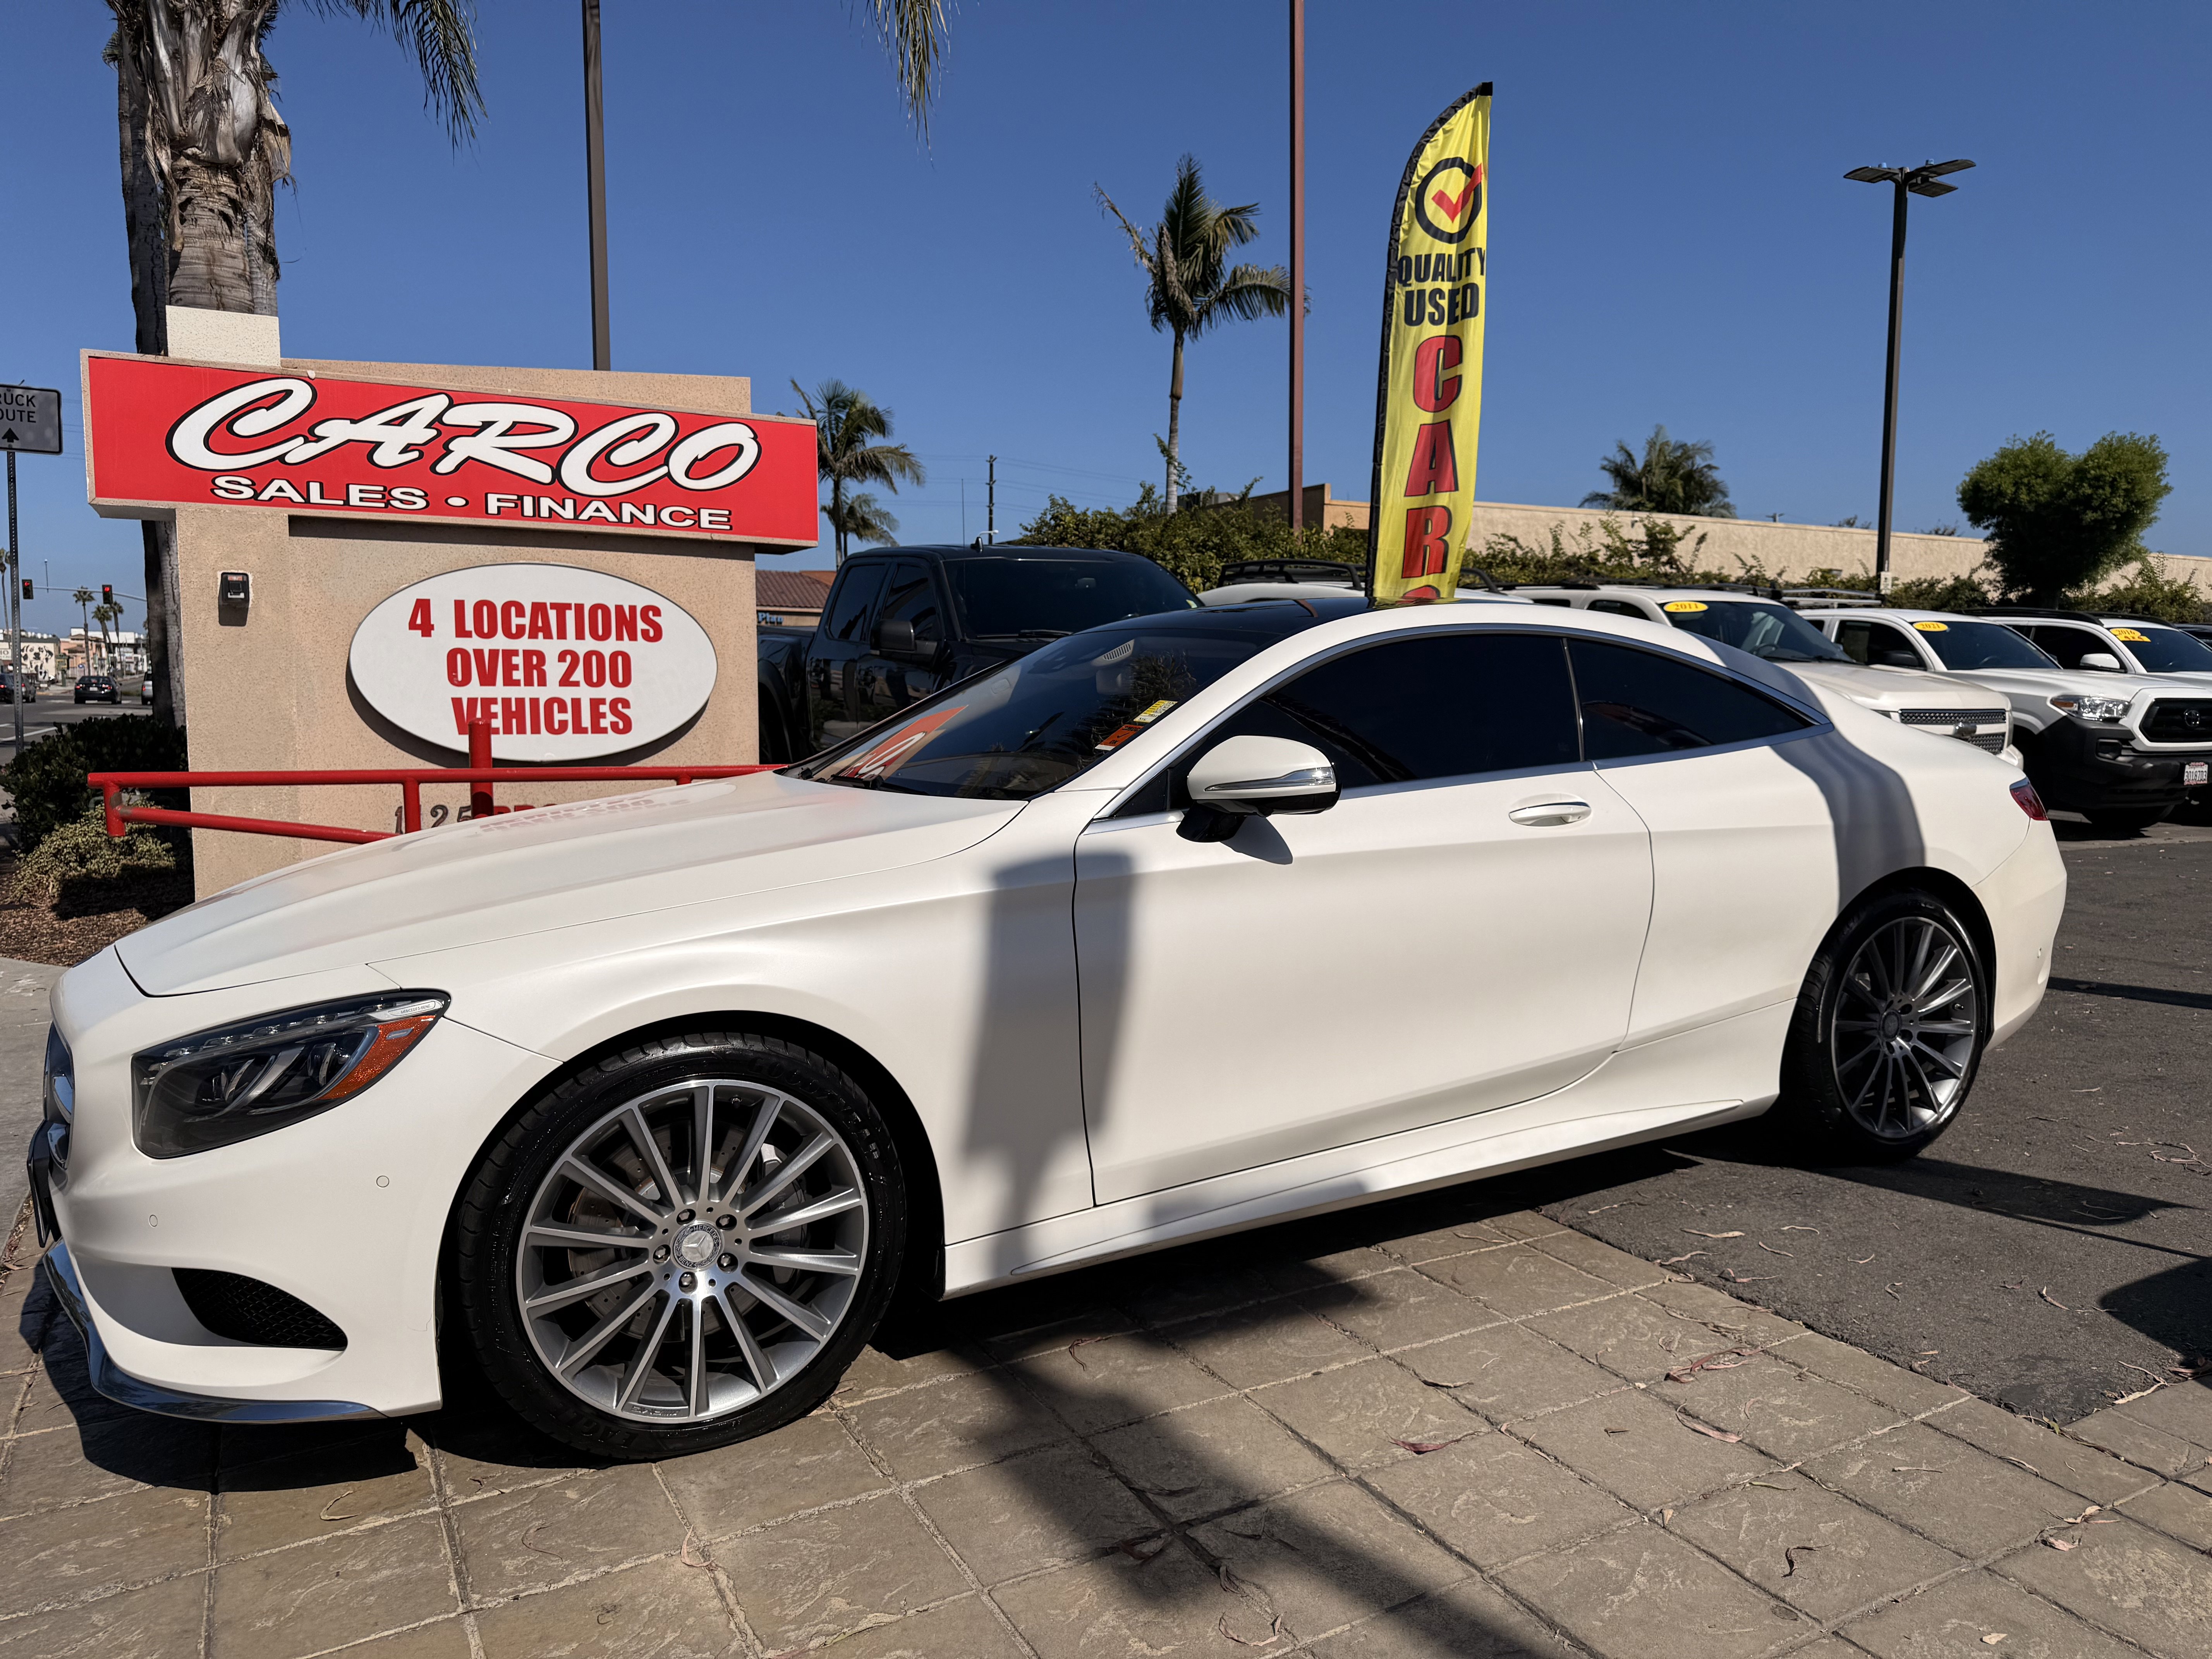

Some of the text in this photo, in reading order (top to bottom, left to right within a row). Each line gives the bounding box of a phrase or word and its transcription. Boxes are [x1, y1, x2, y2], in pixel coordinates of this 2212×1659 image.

[1397, 247, 1486, 287] QUALITY
[1404, 282, 1479, 326] USED
[0, 392, 36, 408] UCK
[167, 377, 762, 497] CARCO
[211, 475, 733, 532] SALES FINANCE
[408, 598, 663, 643] 4 LOCATIONS
[757, 612, 784, 624] Plan
[1673, 603, 1698, 611] 2011
[446, 647, 633, 688] OVER 200
[451, 697, 633, 735] VEHICLES
[394, 804, 472, 835] 125
[400, 1004, 431, 1014] MERCEDES-BENZ
[693, 1225, 719, 1244] MERCEDES
[678, 1255, 694, 1267] BENZ
